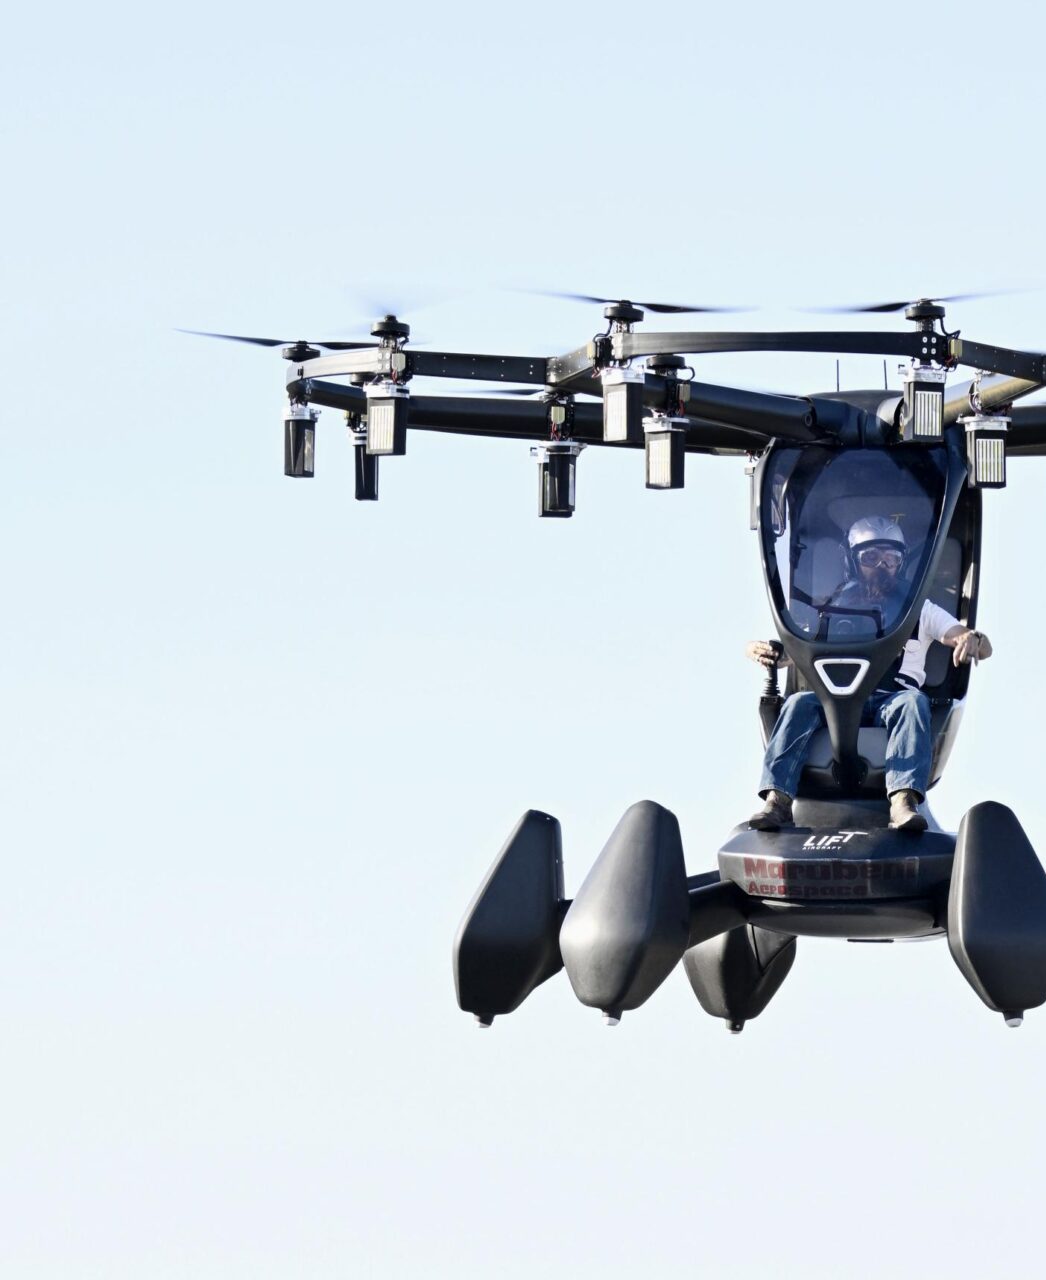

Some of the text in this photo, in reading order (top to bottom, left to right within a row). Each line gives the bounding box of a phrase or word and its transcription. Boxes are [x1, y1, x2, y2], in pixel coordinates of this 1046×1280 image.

[803, 831, 868, 847] LIFT
[743, 856, 917, 881] Marubeni
[748, 880, 868, 897] Aerospace
